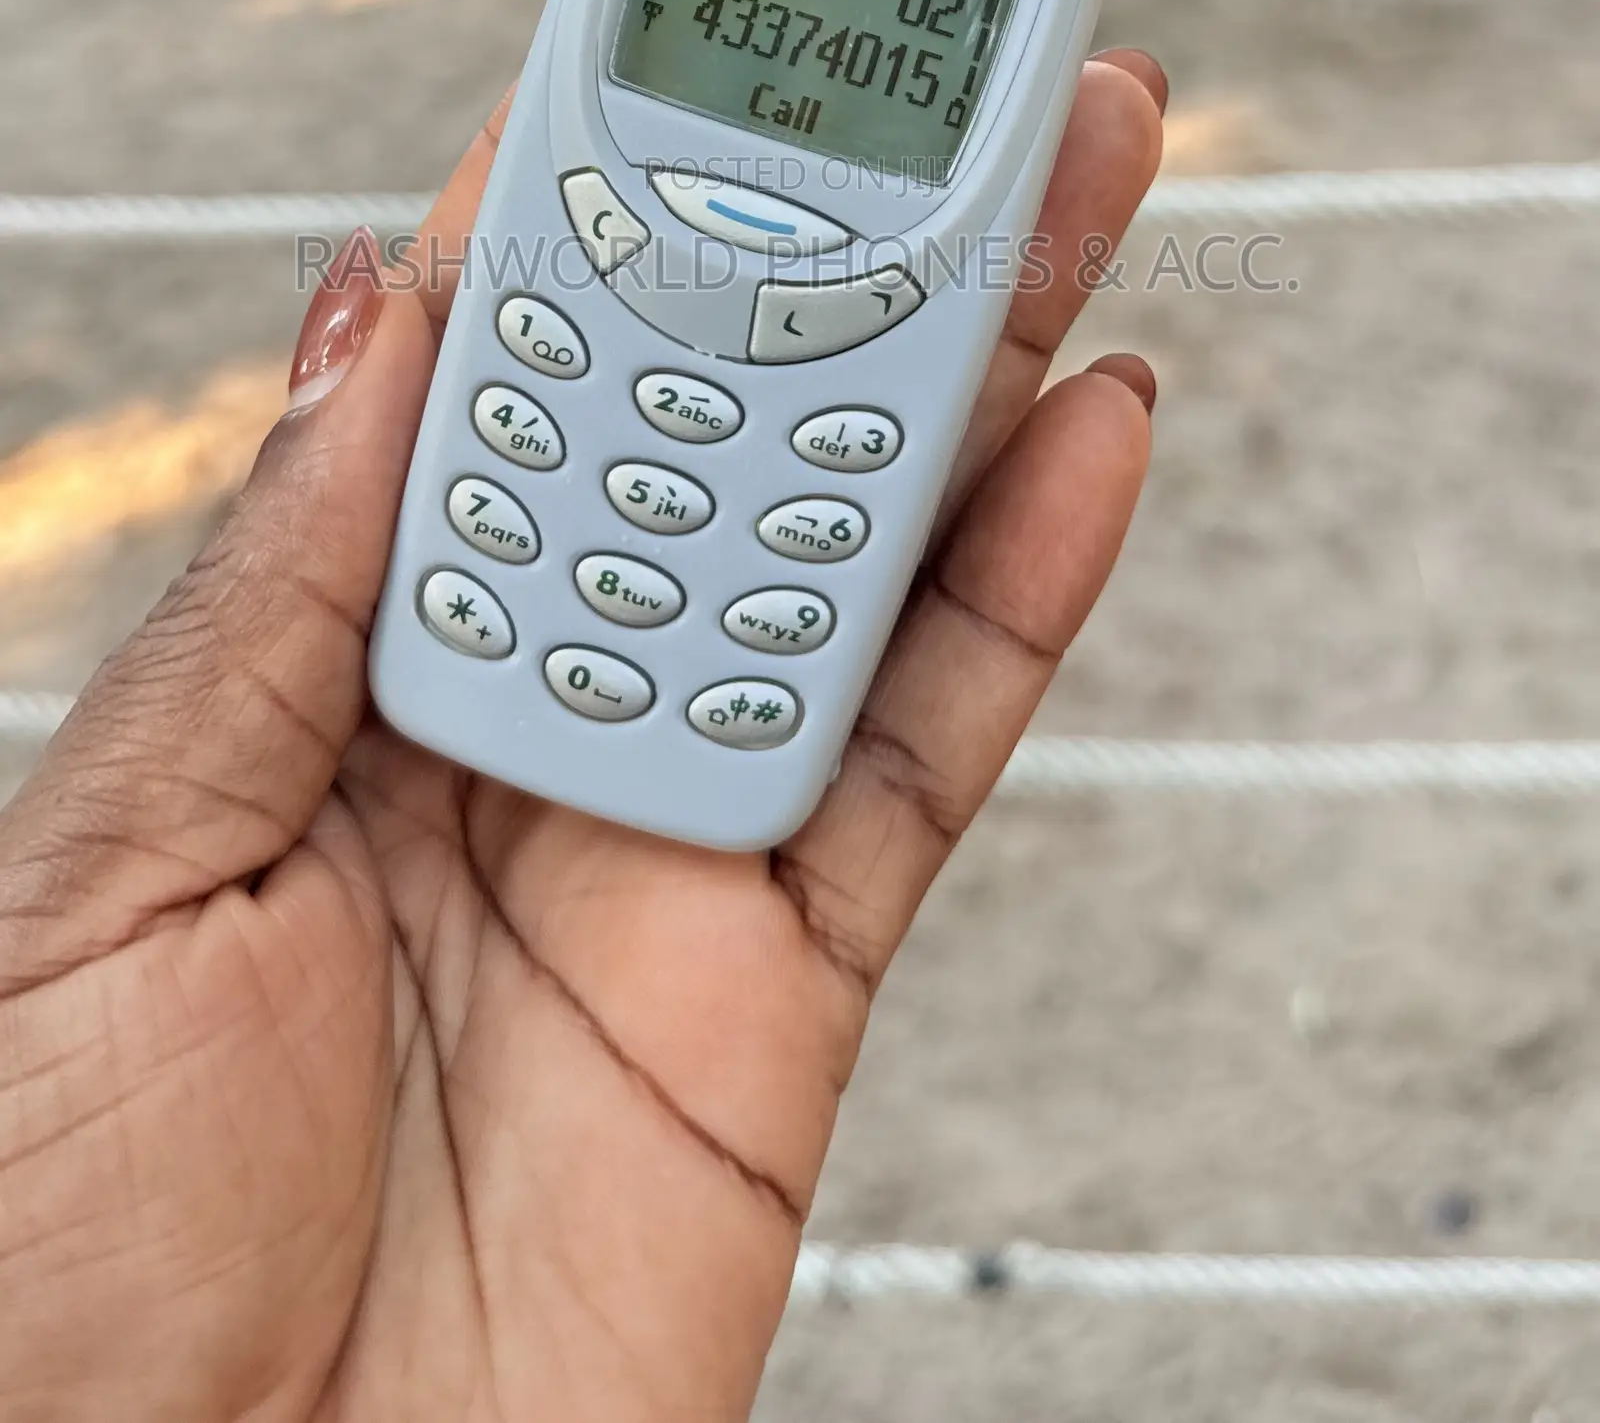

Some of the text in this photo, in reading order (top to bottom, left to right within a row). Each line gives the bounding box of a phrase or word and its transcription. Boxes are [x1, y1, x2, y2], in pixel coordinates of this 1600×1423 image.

[748, 83, 821, 134] Call
[519, 313, 533, 337] 1
[491, 403, 550, 455] 4 ghi
[654, 387, 723, 431] 2 abc
[809, 429, 886, 459] def 3
[467, 492, 530, 549] 7 pqrs
[624, 478, 686, 522] 5 jkl
[776, 517, 852, 551] mno 6
[596, 570, 662, 611] 8 tuv
[739, 605, 820, 642] wxyz 9
[567, 665, 591, 690] 0
